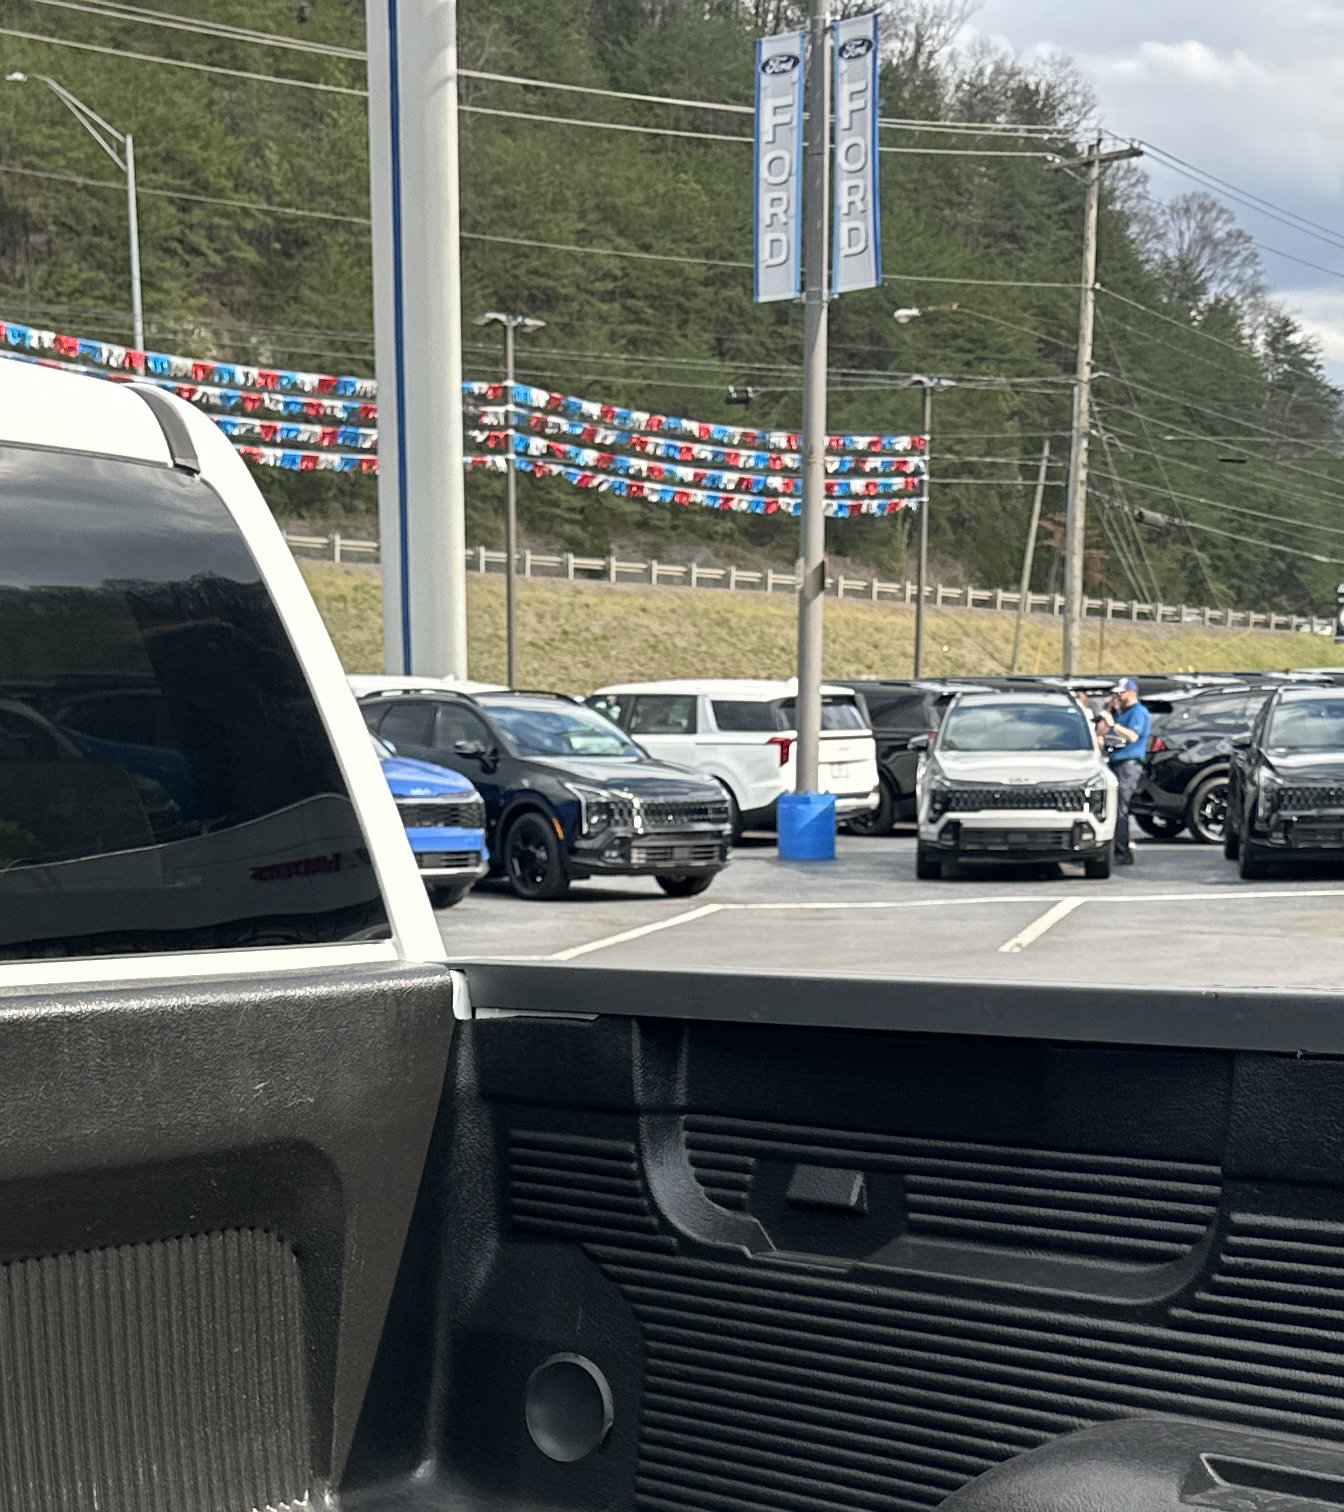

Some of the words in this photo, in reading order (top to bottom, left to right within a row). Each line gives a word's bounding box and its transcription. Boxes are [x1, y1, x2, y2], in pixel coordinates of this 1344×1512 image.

[764, 55, 796, 74] Ford
[842, 40, 870, 59] Ford
[762, 96, 794, 268] FORD
[837, 80, 869, 258] FORD
